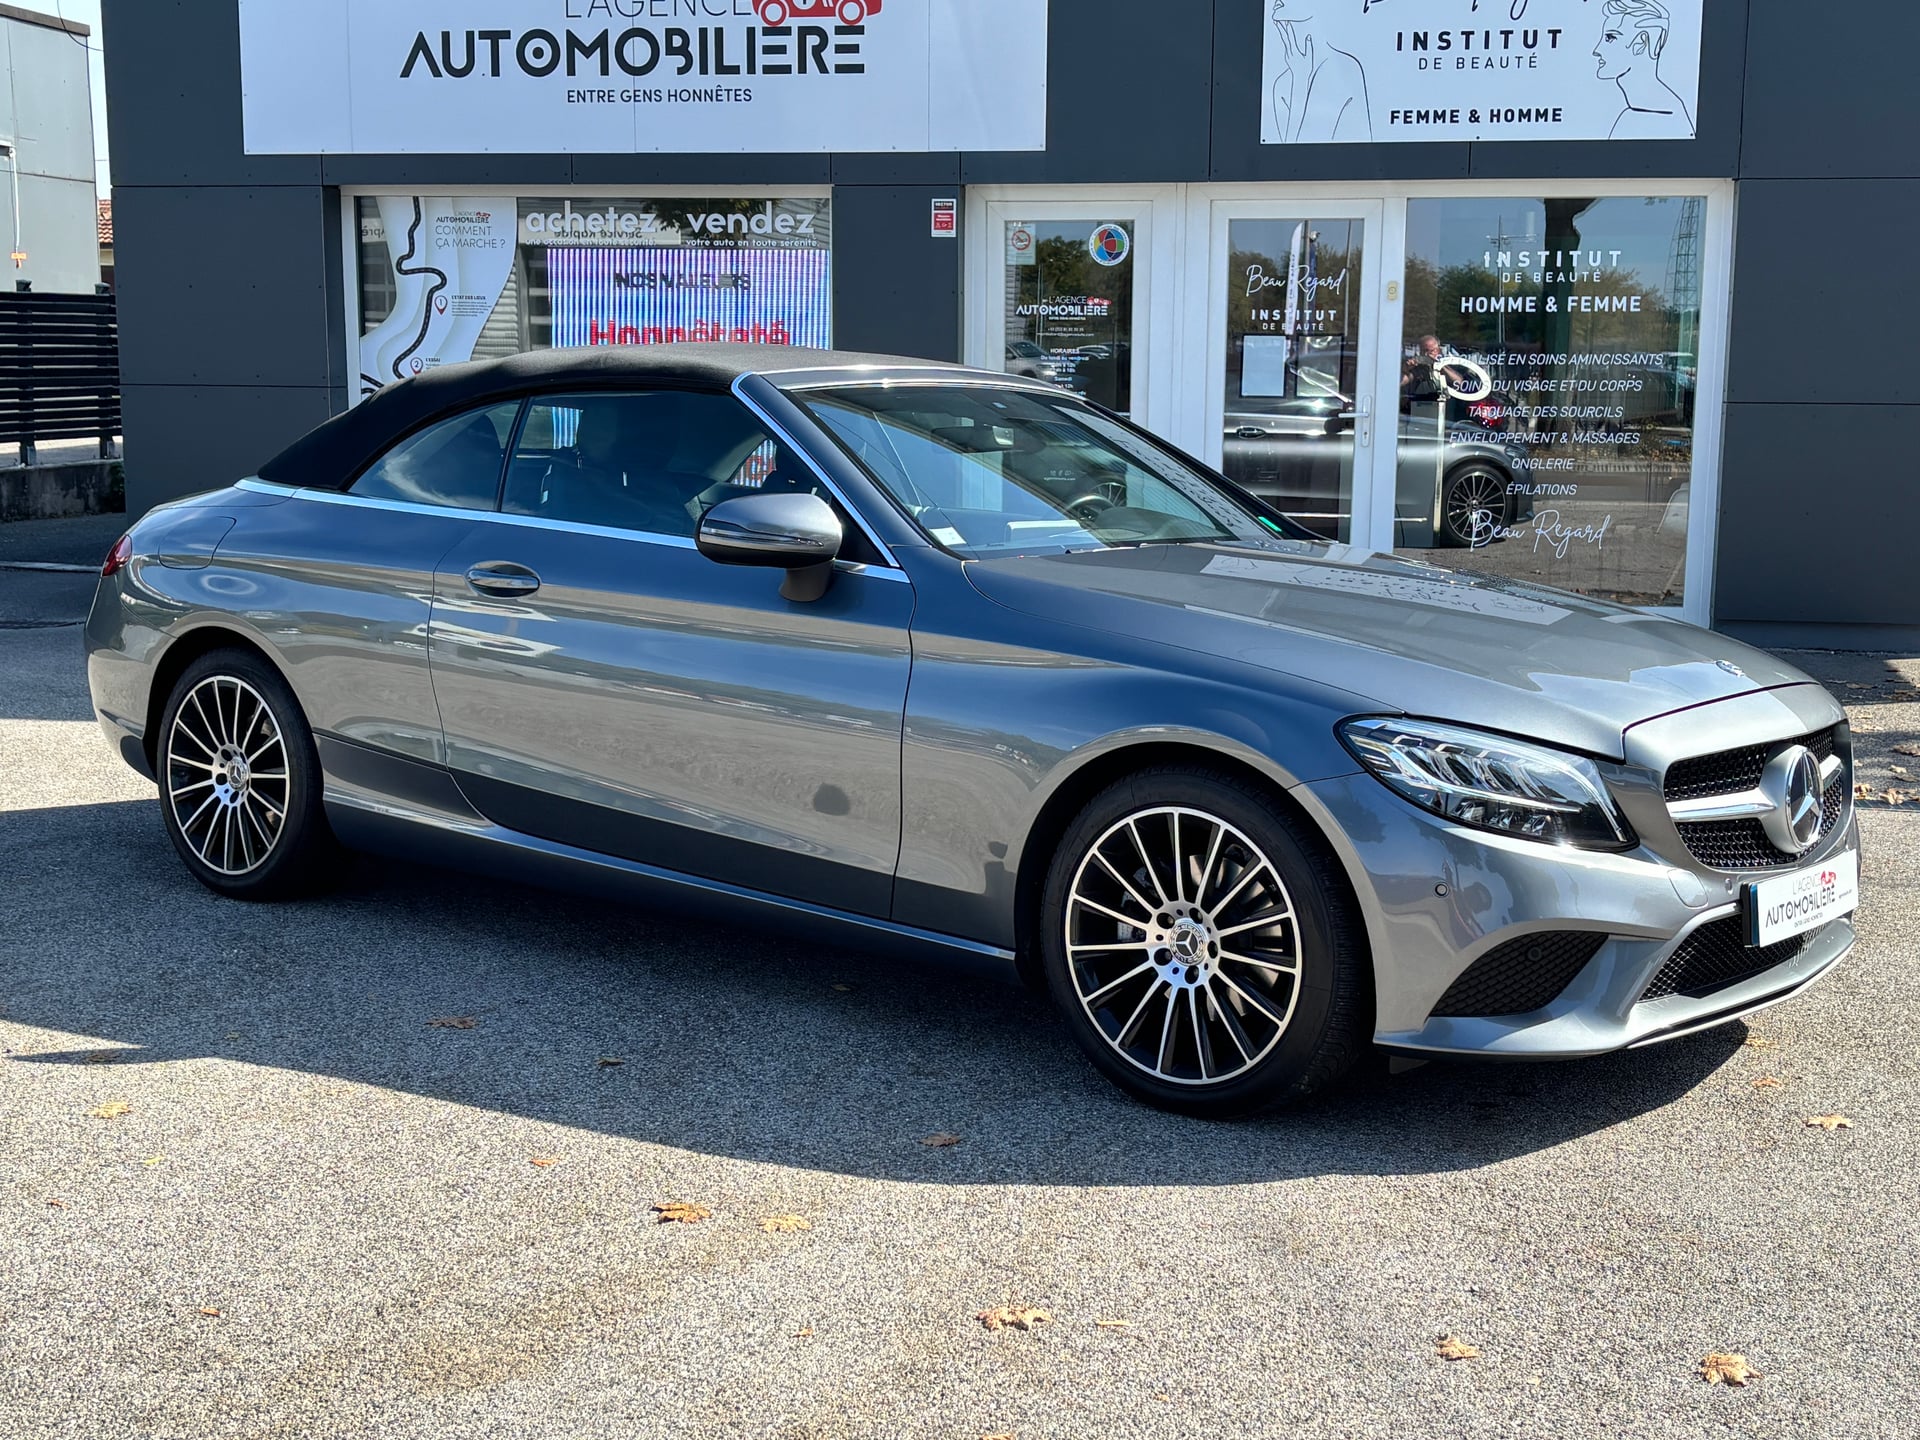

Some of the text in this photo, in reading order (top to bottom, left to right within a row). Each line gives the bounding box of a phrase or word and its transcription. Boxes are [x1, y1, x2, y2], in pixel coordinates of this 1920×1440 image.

[1396, 29, 1563, 51] INSTITUT
[1418, 53, 1539, 70] DE BEAUTÉ
[567, 84, 753, 103] ENTRE GENS HONNÊTES
[1390, 108, 1563, 125] FEMME & HOMME
[525, 200, 816, 234] achetez vendez
[435, 225, 492, 236] COMMENT
[435, 237, 506, 249] ÇA MARCHE ?
[686, 239, 710, 247] votre
[713, 239, 735, 247] auto
[752, 239, 777, 247] toute
[1483, 250, 1622, 267] INSTITUT
[614, 273, 658, 290] NOS
[1246, 265, 1286, 297] Beau
[1294, 264, 1346, 301] Regard
[1502, 269, 1602, 283] DE BEAUTÉ
[1461, 296, 1642, 313] HOMME & FEMME
[1262, 322, 1276, 330] DE
[1508, 353, 1526, 365] EN
[1527, 353, 1566, 365] SOINS
[1568, 353, 1664, 365] AMINCISSANTS
[1492, 380, 1511, 391] DU
[1514, 380, 1557, 391] VISAGE
[1599, 380, 1643, 391] CORPS
[1532, 406, 1557, 418] DES
[1559, 406, 1624, 418] SOURCILS
[1449, 431, 1641, 444] ENVELOPPEMENT & MASSAGES
[1511, 458, 1576, 470] ONGLERIE
[1505, 482, 1578, 495] ÉPILATIONS
[1469, 509, 1611, 559] Beau Regard
